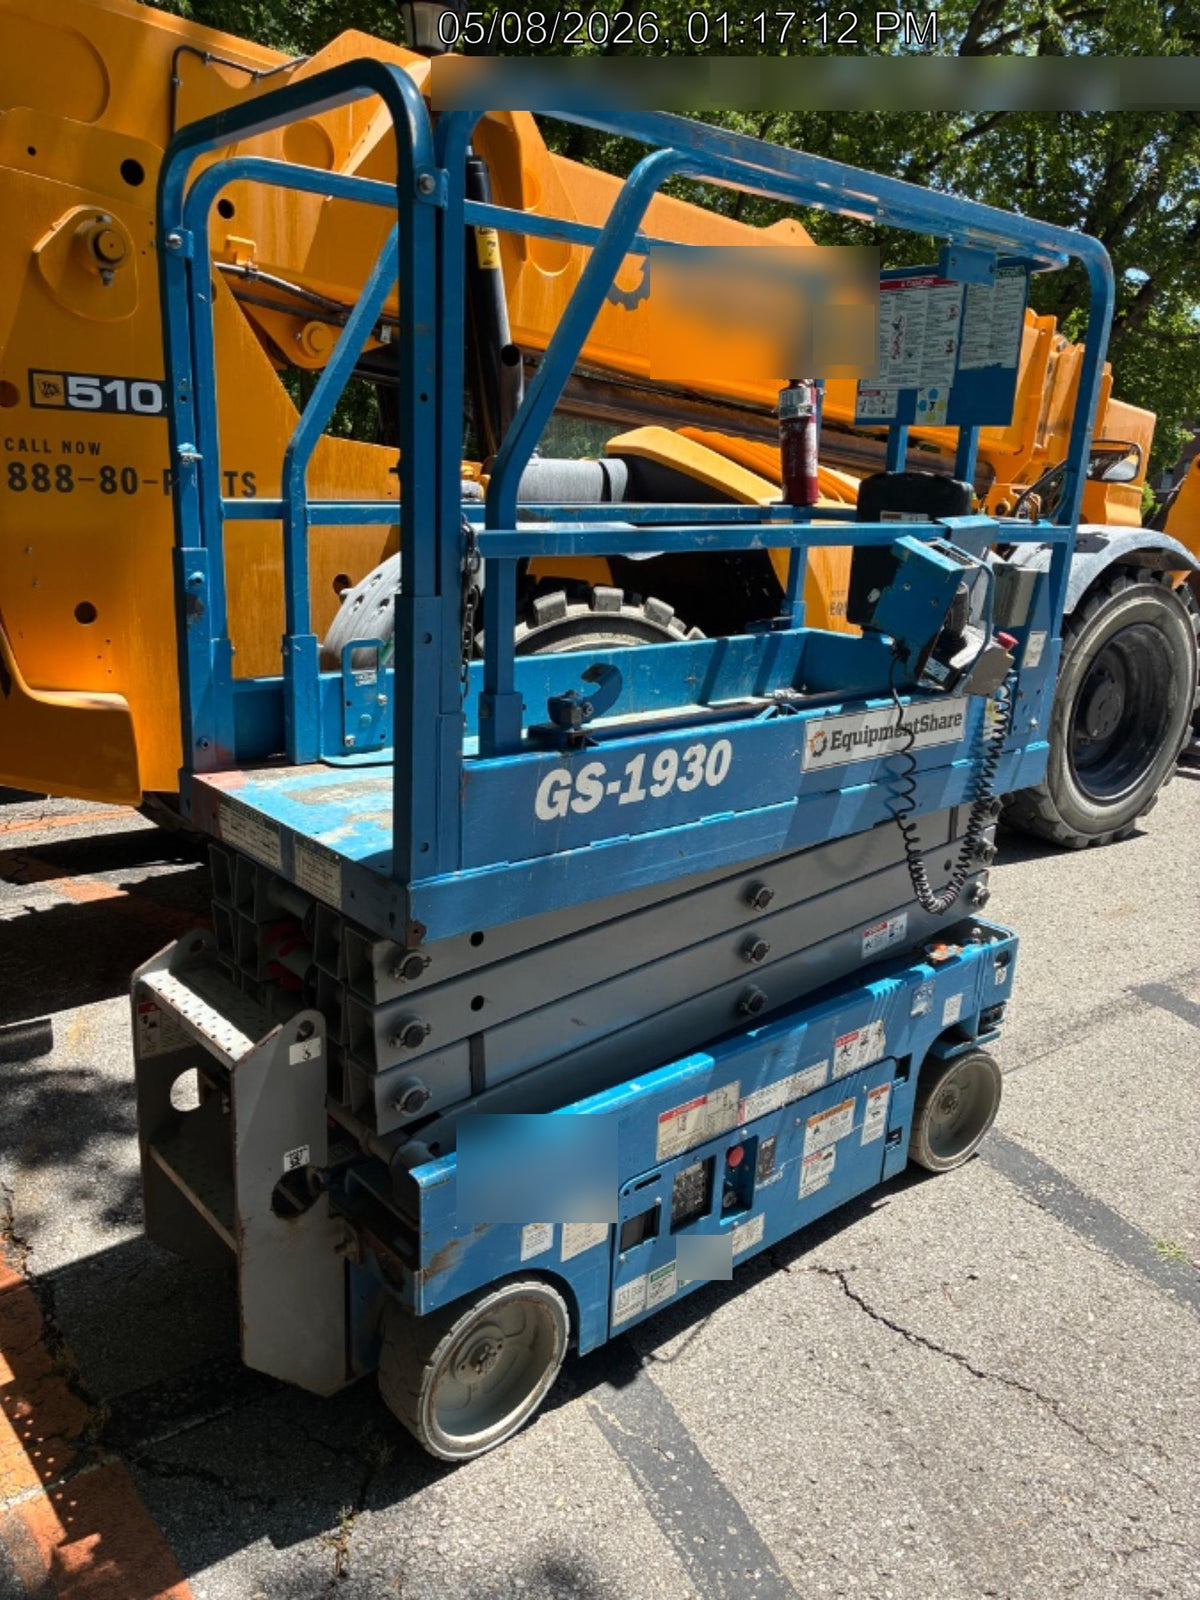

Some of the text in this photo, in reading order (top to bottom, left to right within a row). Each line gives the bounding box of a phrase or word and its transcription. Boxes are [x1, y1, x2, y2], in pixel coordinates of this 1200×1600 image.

[4, 436, 101, 456] CALL NOW
[829, 712, 963, 752] EquipmentShare
[534, 738, 733, 821] GS-1930
